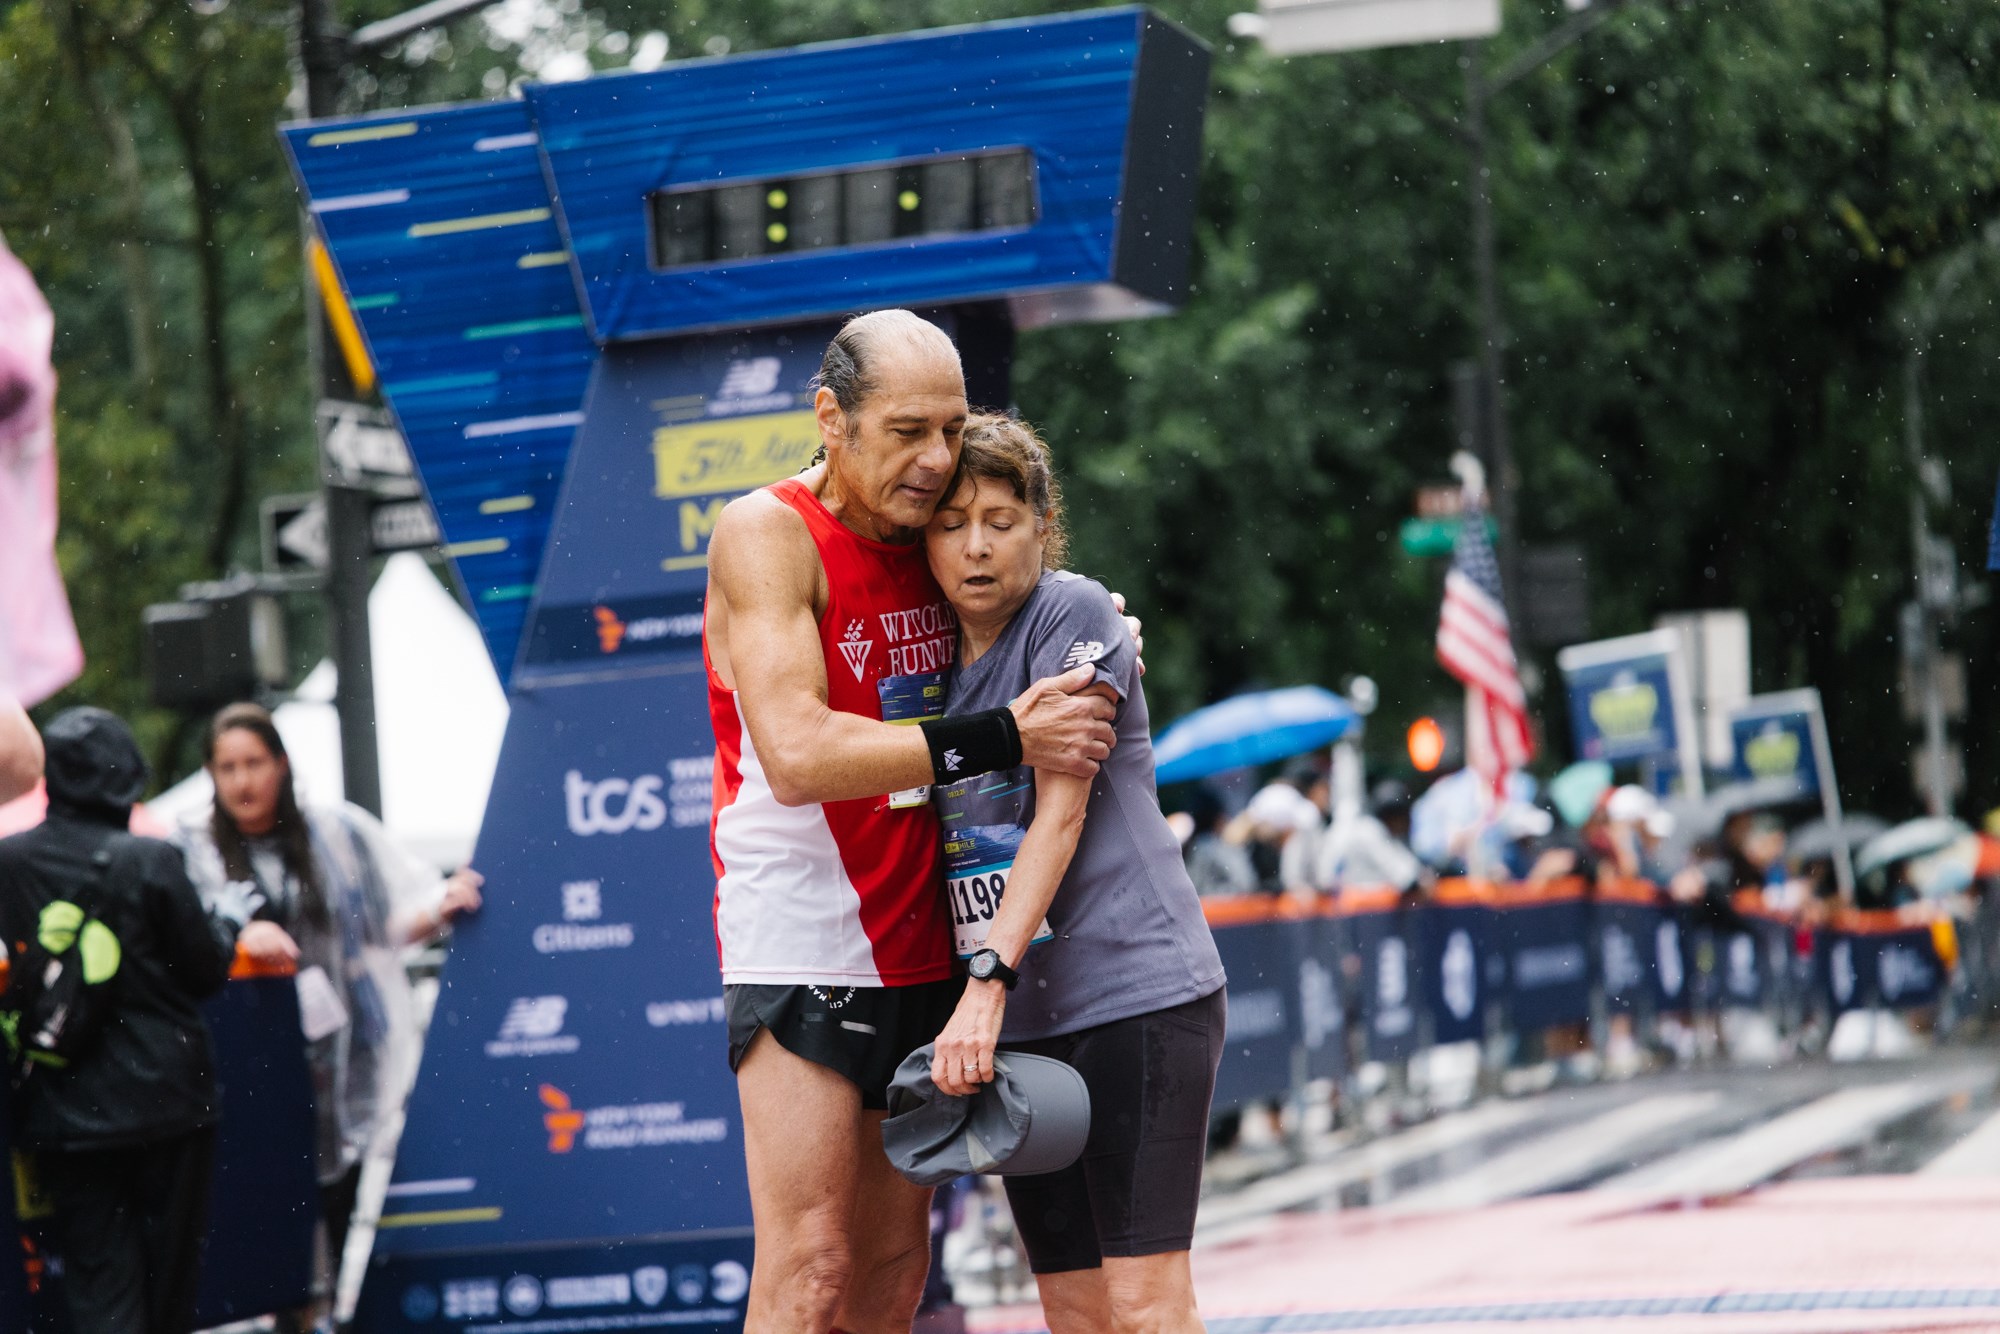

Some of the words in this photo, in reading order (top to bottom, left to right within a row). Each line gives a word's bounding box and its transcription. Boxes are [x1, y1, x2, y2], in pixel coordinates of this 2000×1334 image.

[878, 600, 957, 643] WITOLD
[564, 768, 667, 836] tcs
[959, 839, 976, 849] MILE
[949, 873, 1006, 925] 1198
[646, 996, 725, 1027] UNIT
